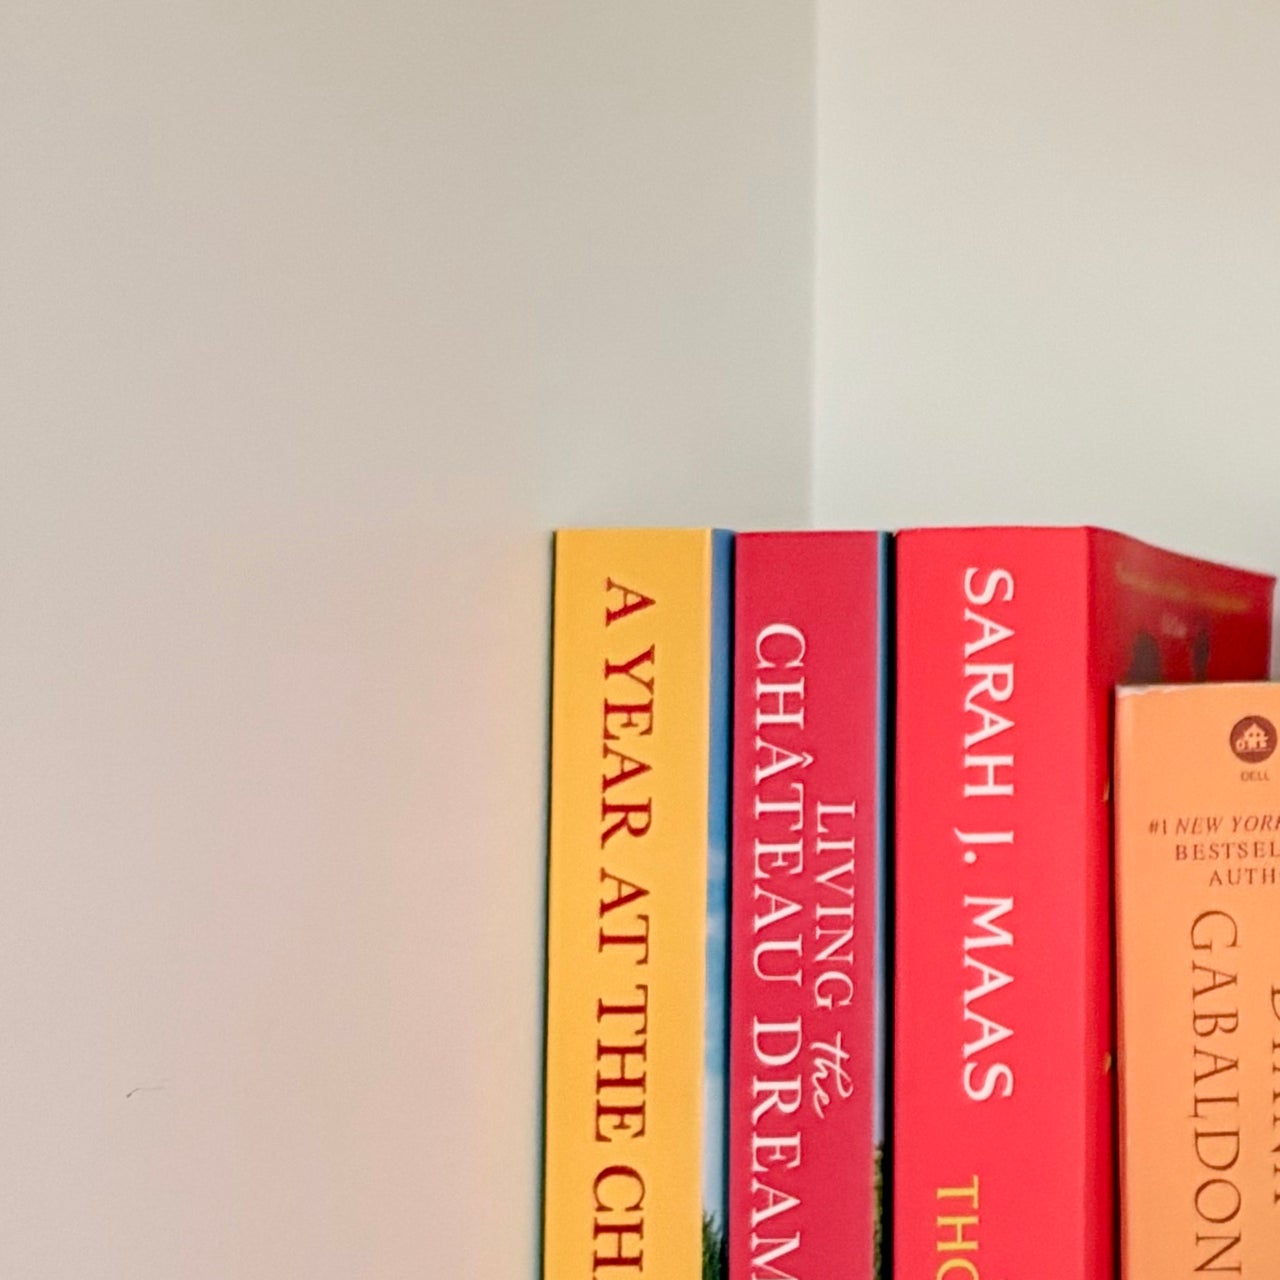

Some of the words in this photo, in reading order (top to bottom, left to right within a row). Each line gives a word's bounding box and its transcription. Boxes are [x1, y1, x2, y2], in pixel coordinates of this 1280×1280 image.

[605, 577, 656, 627] A
[963, 566, 1014, 797] SARAH
[600, 643, 655, 849] YEAR
[753, 623, 813, 987] CHÂTEAU
[1240, 771, 1270, 781] DELL
[815, 800, 856, 1010] LIVING
[954, 829, 1014, 865] J.
[1149, 819, 1167, 835] #1
[1175, 817, 1223, 835] NEW
[599, 867, 650, 965] AT
[594, 984, 649, 1143] THE
[810, 1031, 854, 1119] the
[963, 895, 1014, 1102] MAAS
[1190, 909, 1243, 1275] GABALDON
